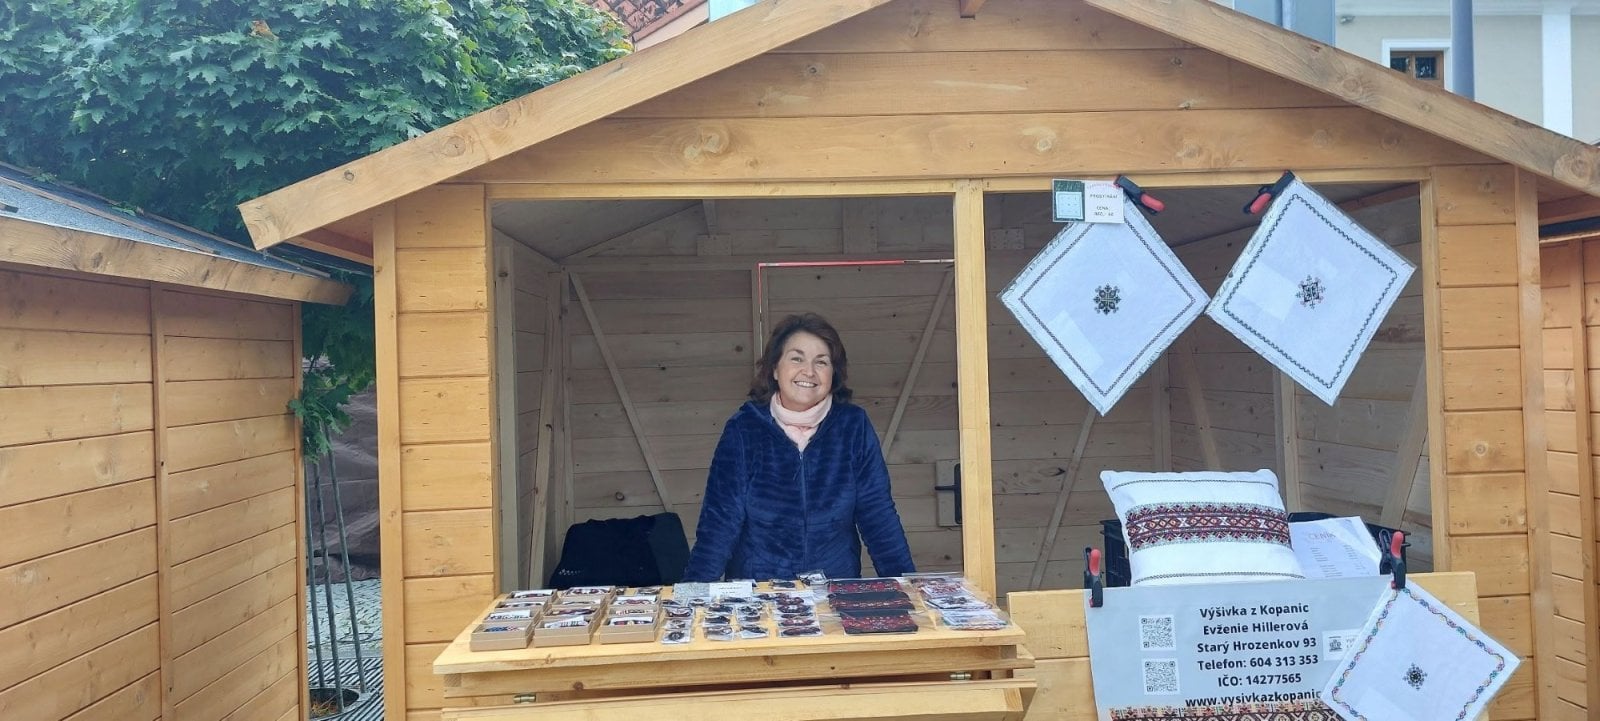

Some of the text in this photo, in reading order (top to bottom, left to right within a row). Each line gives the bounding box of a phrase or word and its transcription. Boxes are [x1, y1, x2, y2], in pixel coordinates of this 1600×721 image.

[1200, 602, 1309, 620] Výšivka z Kopanic
[1203, 620, 1309, 635] Evženie Hillerová
[1197, 637, 1317, 654] Starý Hrozenkov 93
[1197, 654, 1319, 671] Telefon: 604 313 353
[1218, 673, 1302, 687] IČO: 14277565
